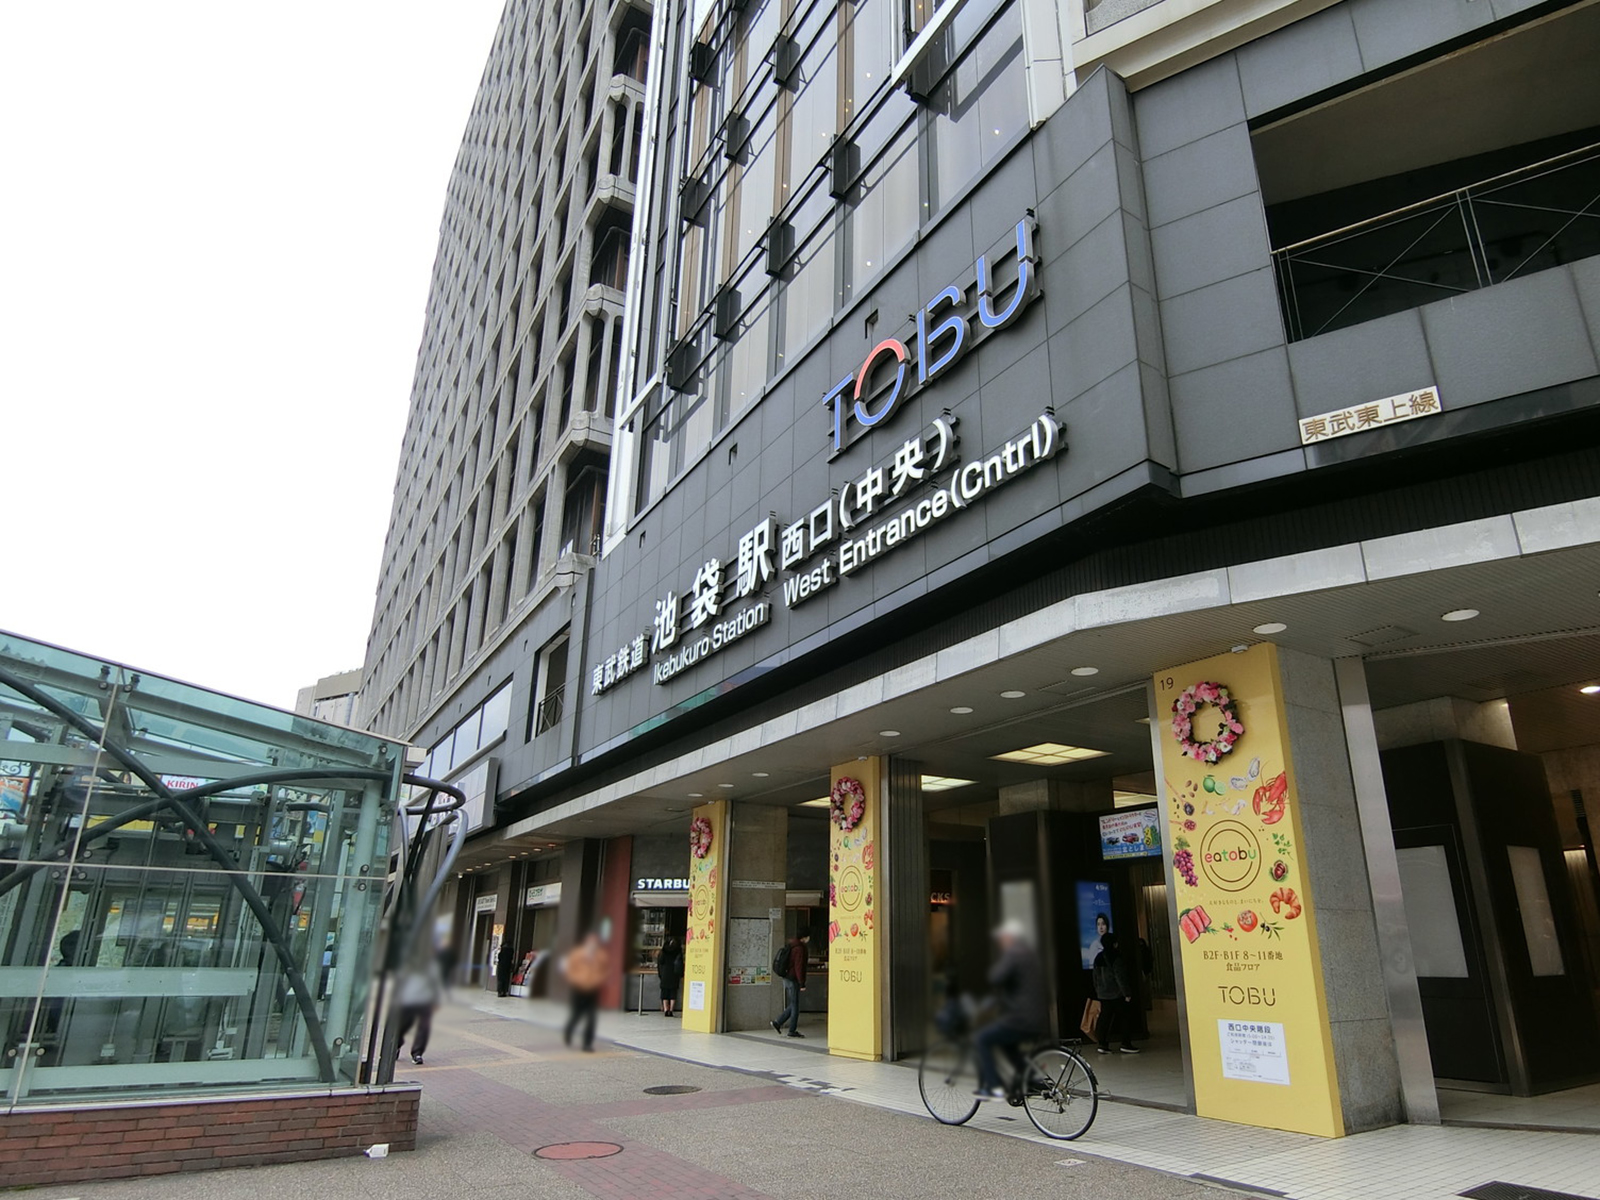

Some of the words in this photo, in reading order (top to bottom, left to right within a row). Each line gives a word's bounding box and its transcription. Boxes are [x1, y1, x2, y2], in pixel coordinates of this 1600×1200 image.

[822, 219, 1034, 450] TOBU
[1302, 391, 1439, 442] 東武東上線
[587, 633, 645, 695] 東武鉄道
[652, 519, 773, 655] 池袋駅
[782, 418, 952, 571] 西口(中央)
[653, 636, 709, 685] Ikebukuro
[712, 602, 764, 649] Station
[783, 558, 831, 607] West
[1159, 676, 1174, 691] 19
[166, 780, 199, 789] KIRIN
[1204, 846, 1257, 863] eatobu
[839, 969, 863, 983] TOBU
[1226, 962, 1261, 972] 食品フロア
[1217, 985, 1276, 1007] TOBU
